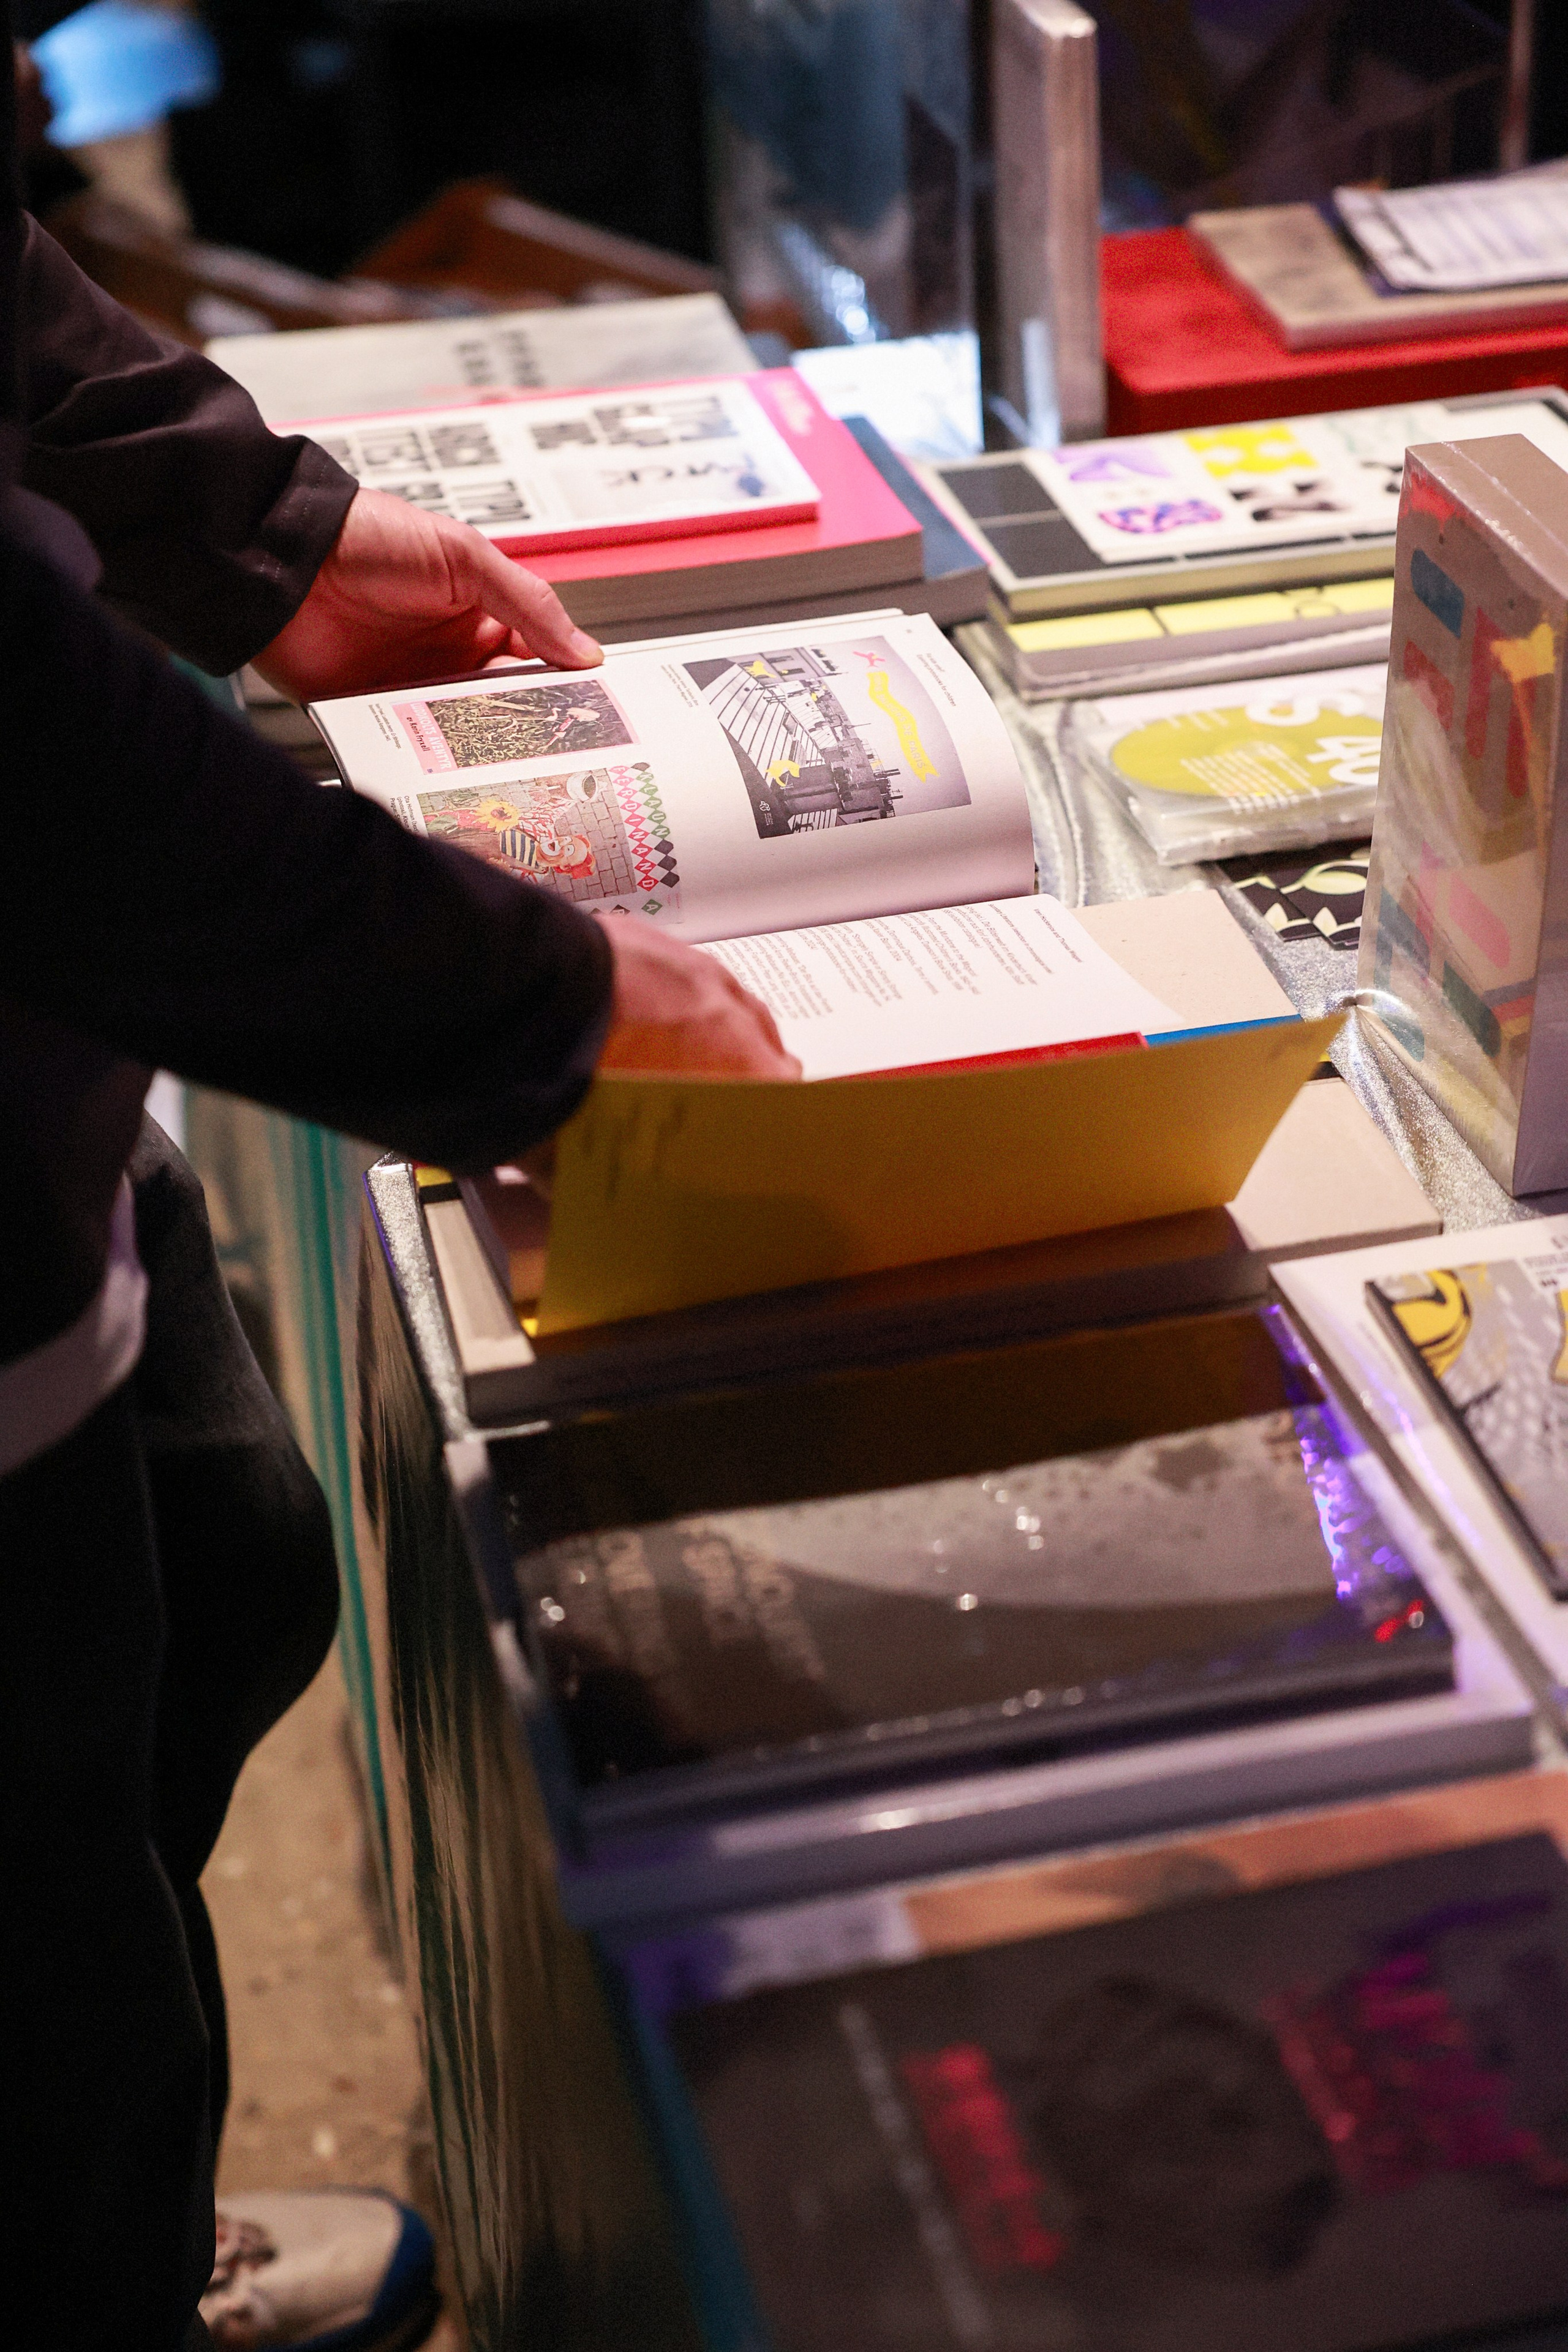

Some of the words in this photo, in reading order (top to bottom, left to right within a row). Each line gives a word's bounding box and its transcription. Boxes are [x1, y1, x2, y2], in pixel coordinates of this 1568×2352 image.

[944, 691, 956, 707] children
[410, 722, 420, 735] Karin
[416, 734, 431, 752] Fryxell
[903, 723, 913, 737] DE
[909, 741, 926, 769] PARIS
[428, 736, 452, 769] ÄVENTYR
[639, 772, 668, 837] KLAUN
[613, 766, 655, 888] FERDINAND
[1000, 914, 1014, 927] Literature
[872, 928, 884, 937] Xavier
[887, 930, 905, 949] Dominique
[911, 927, 924, 940] Angeles:
[922, 925, 940, 943] Illustrated
[940, 931, 956, 948] Mundane
[987, 927, 1006, 946] Bilderwelt
[1041, 916, 1055, 932] Hockenjos
[1060, 938, 1071, 951] Thomas
[854, 955, 867, 968] Source
